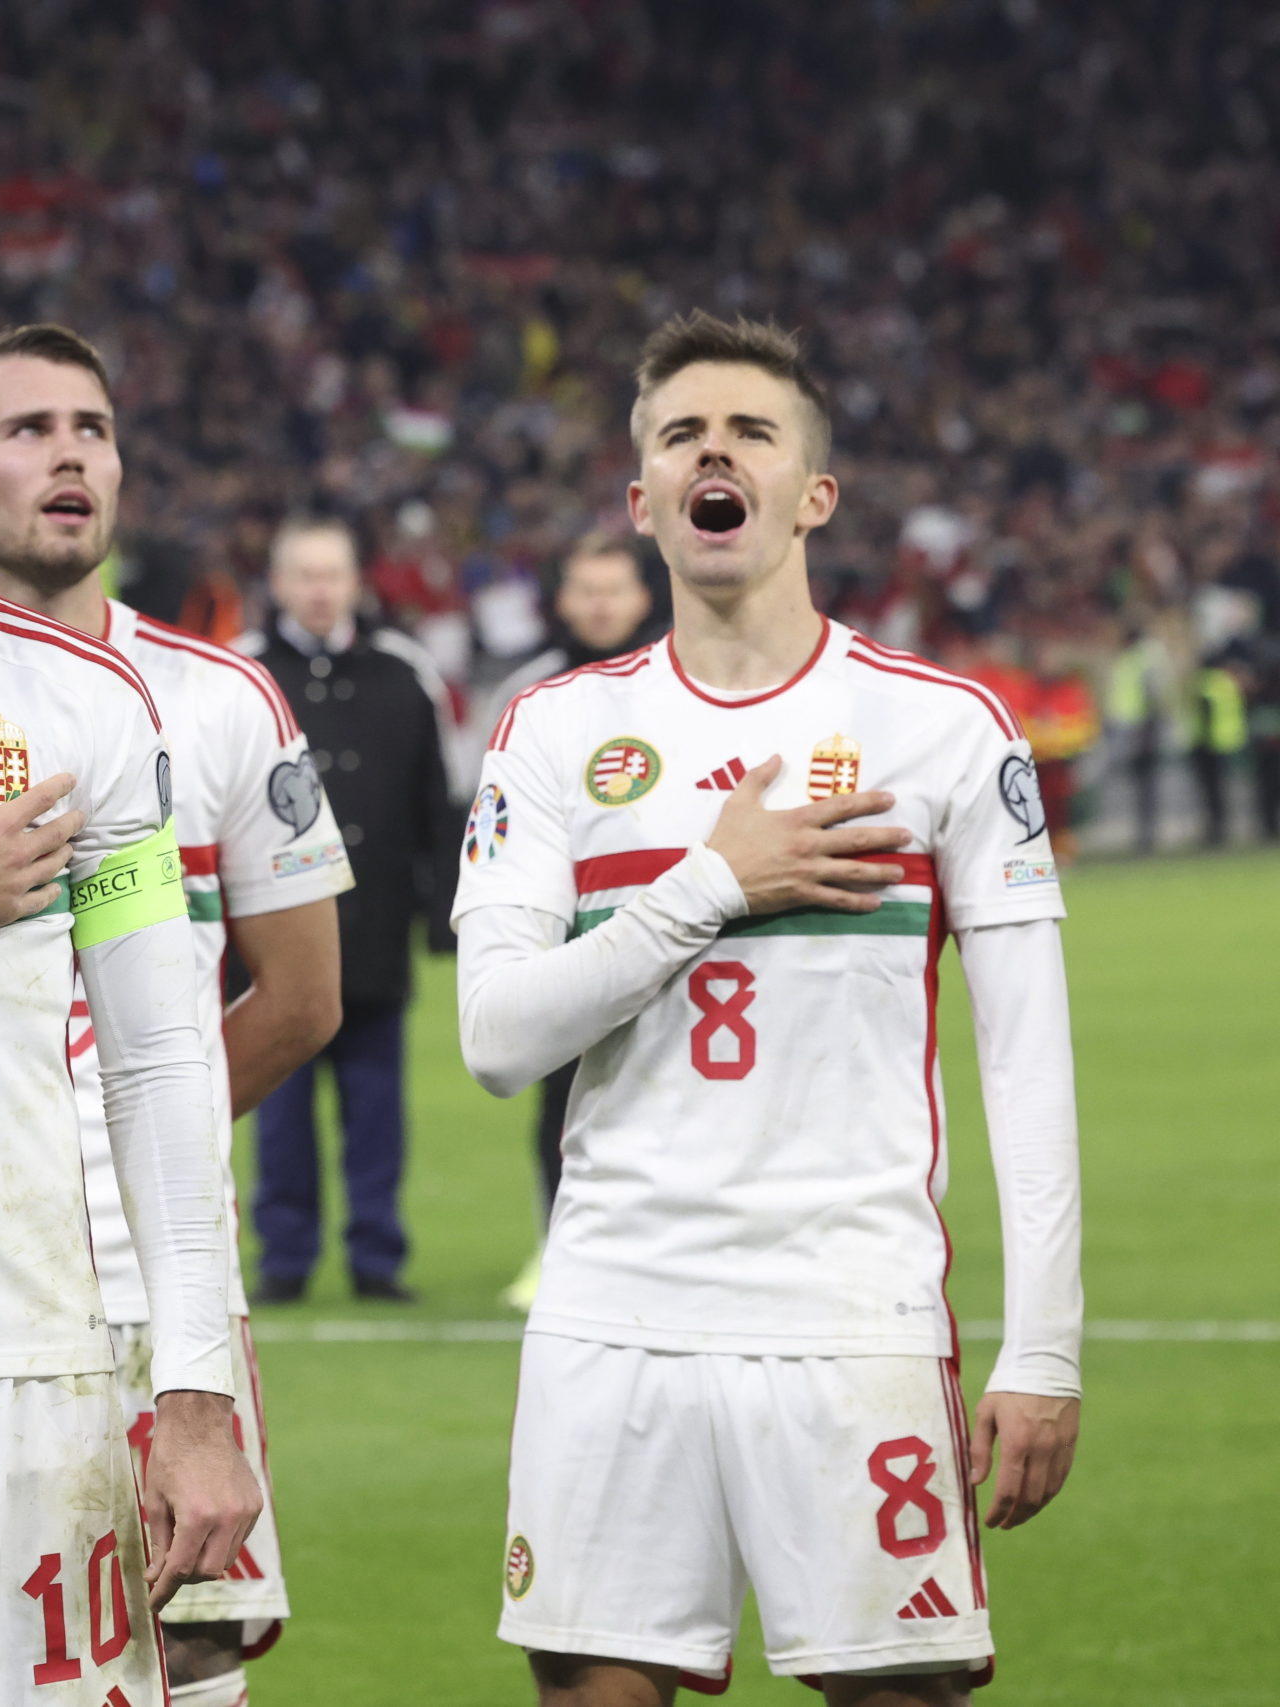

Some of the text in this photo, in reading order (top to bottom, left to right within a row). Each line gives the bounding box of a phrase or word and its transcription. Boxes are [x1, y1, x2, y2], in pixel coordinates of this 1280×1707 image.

[70, 868, 138, 909] ESPECT
[688, 961, 756, 1079] 8
[868, 1436, 947, 1559] 8
[22, 1530, 132, 1685] 10
